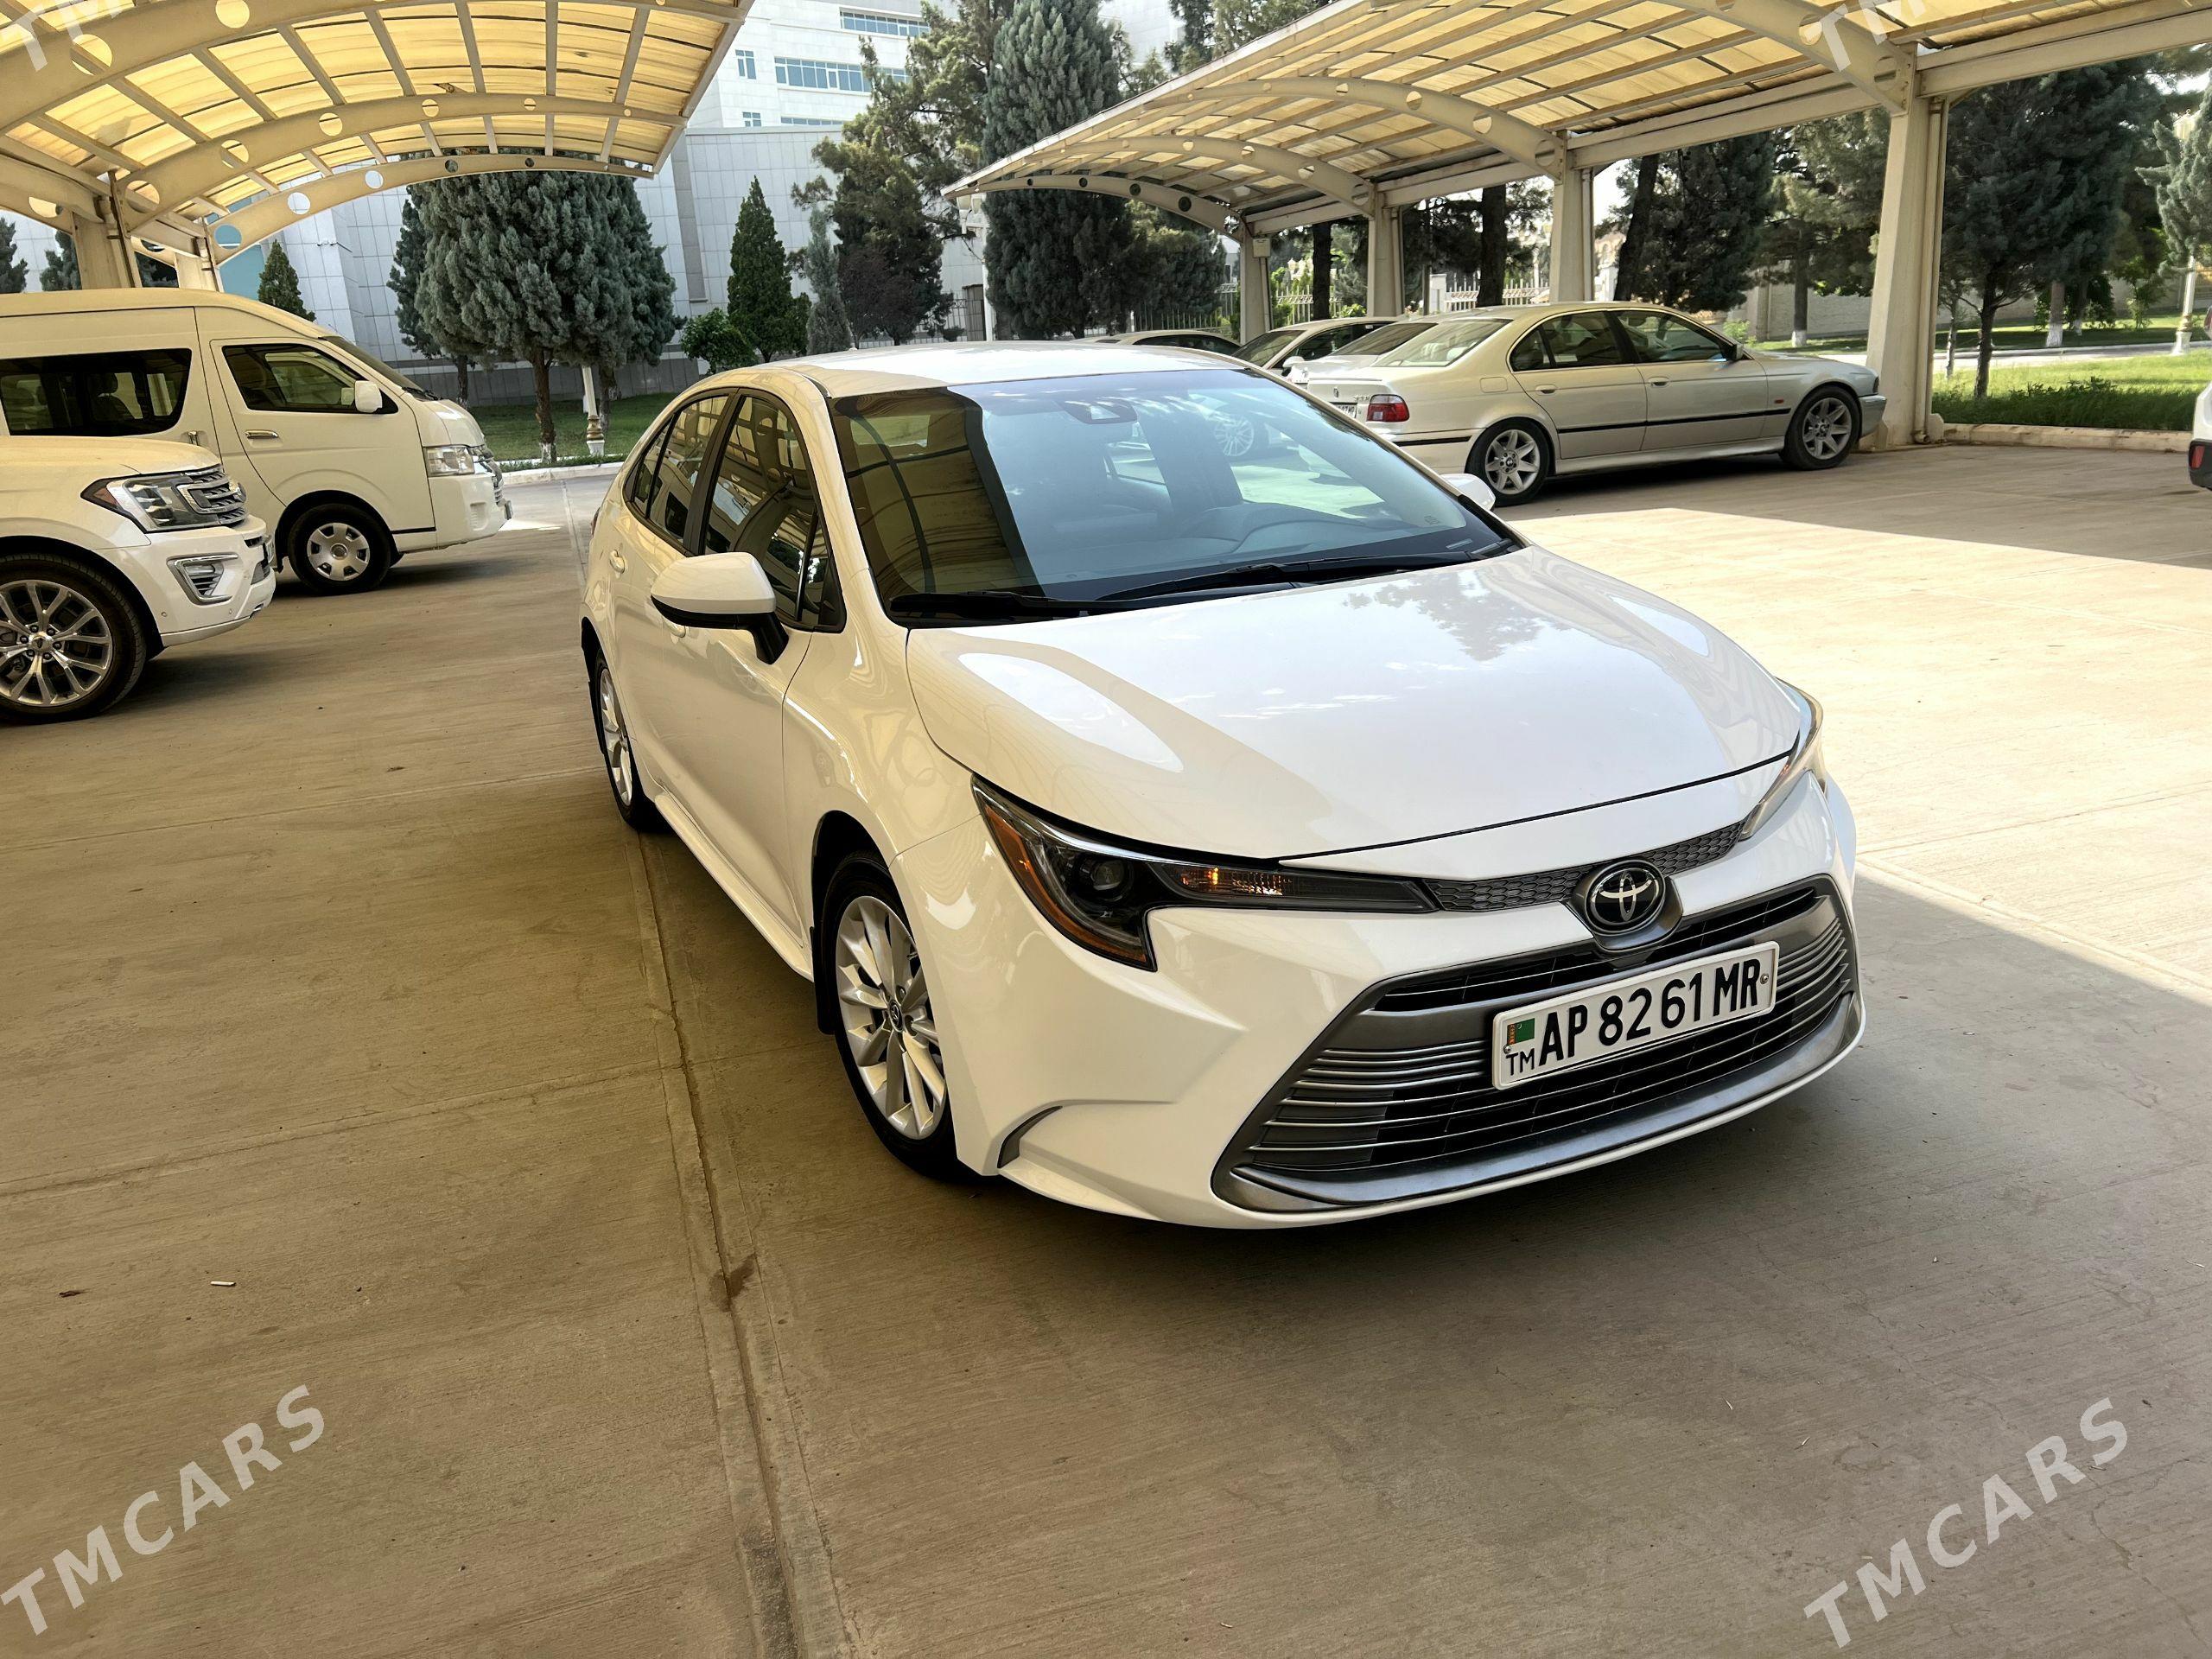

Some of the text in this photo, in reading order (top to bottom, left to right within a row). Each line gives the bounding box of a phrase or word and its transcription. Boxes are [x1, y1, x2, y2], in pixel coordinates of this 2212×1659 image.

[1538, 1004, 1588, 1067] AP
[1713, 958, 1762, 1017] MR
[1505, 1047, 1535, 1077] TM
